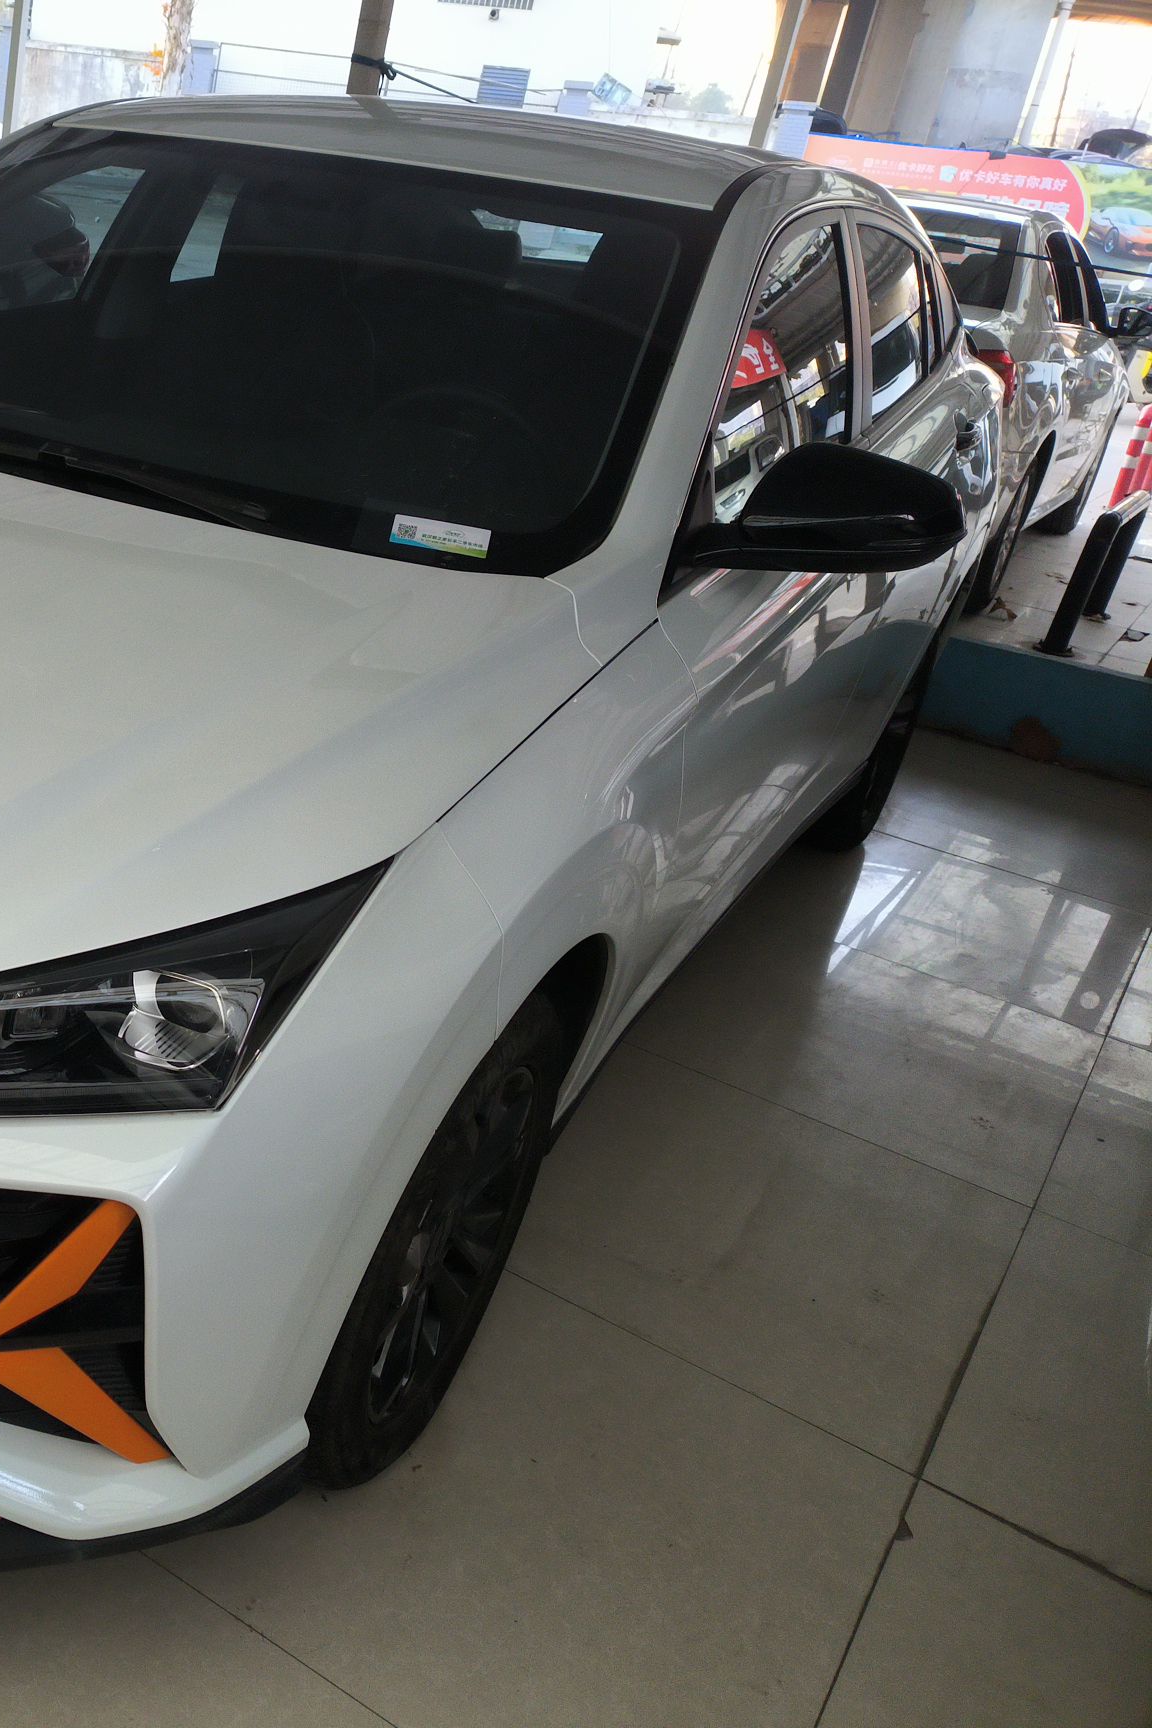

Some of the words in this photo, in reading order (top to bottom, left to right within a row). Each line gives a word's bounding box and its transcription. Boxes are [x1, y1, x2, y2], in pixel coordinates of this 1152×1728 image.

[959, 168, 1068, 192] 优卡好车有你真好
